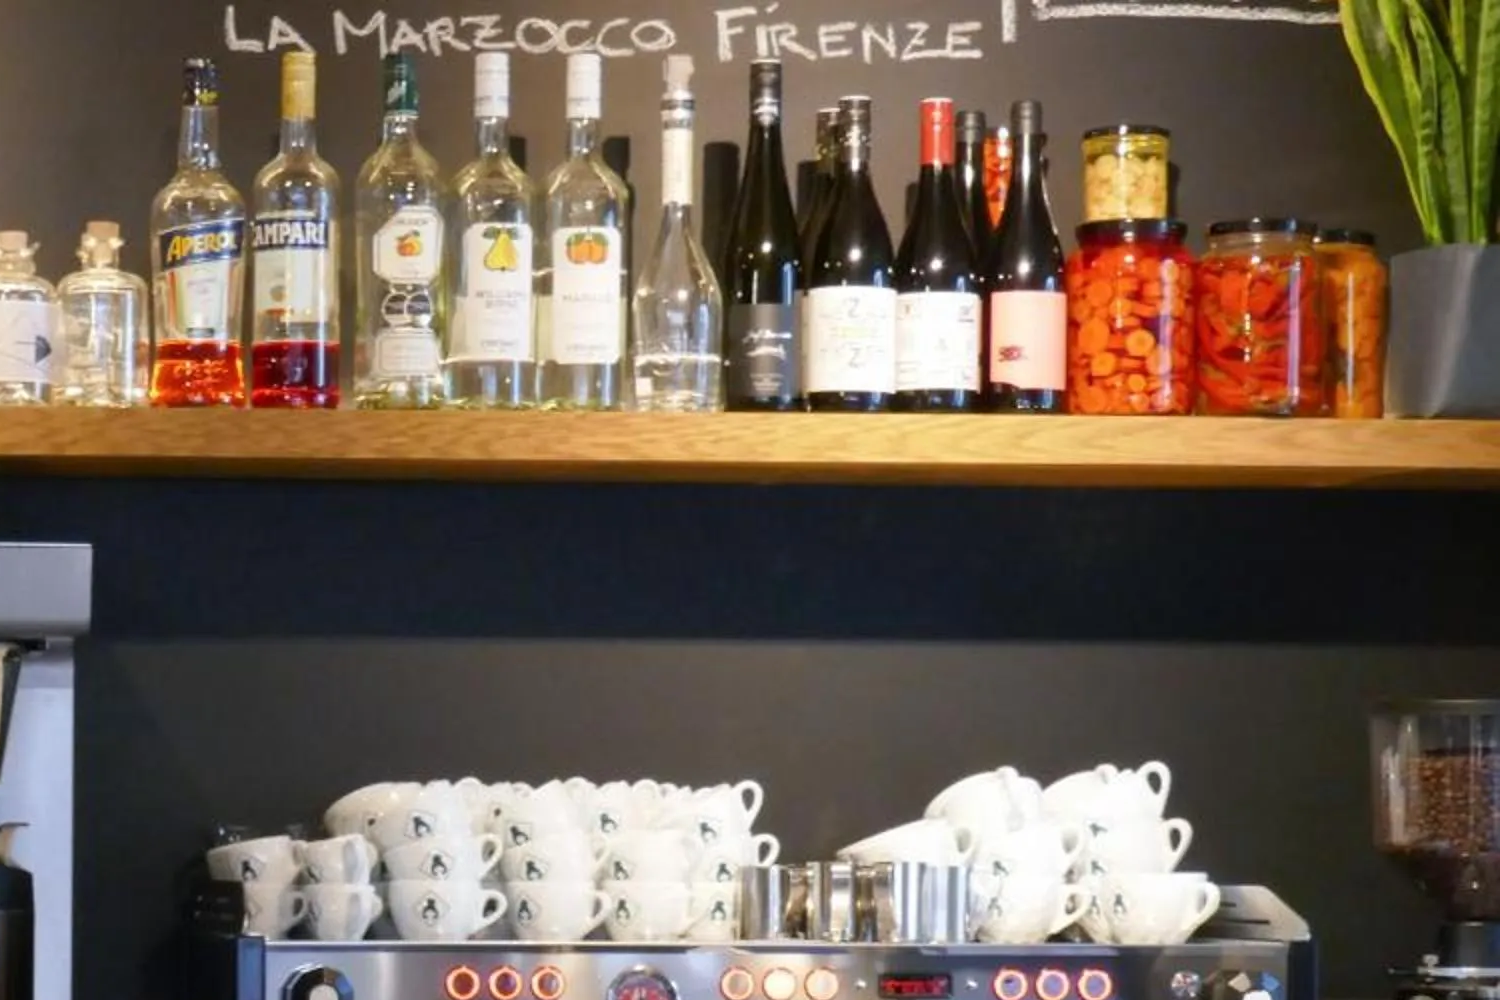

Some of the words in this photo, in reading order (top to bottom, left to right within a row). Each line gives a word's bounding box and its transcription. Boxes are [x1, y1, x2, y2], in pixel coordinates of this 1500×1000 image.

[223, 4, 315, 53] LA
[333, 10, 677, 58] MARZOCCO
[166, 230, 237, 263] APEROL
